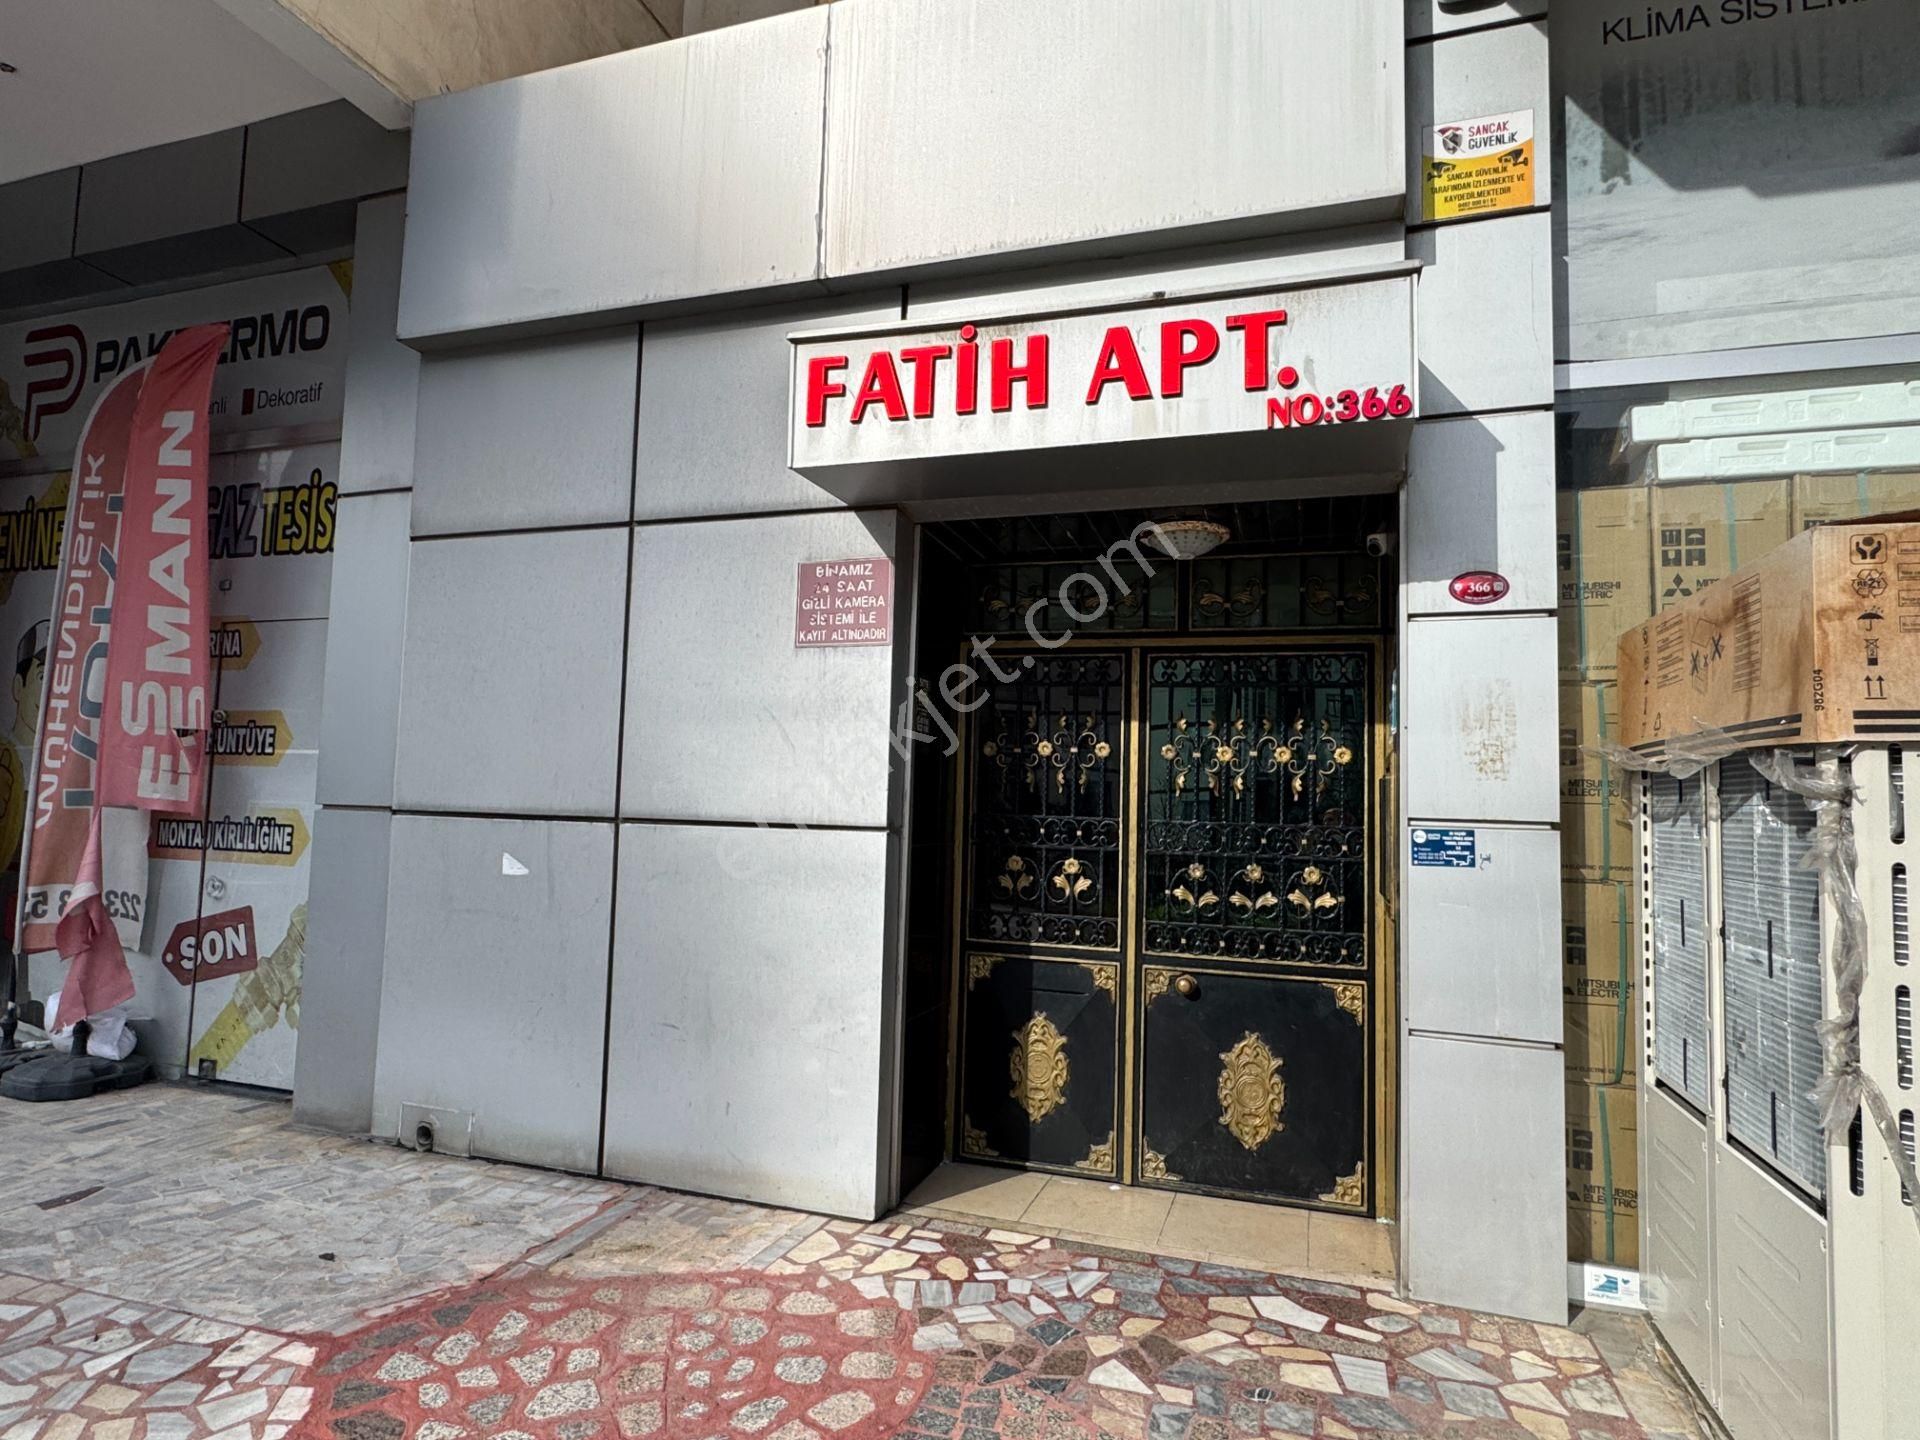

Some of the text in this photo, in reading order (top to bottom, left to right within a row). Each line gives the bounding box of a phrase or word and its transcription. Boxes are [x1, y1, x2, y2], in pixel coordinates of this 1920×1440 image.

[1602, 5, 1710, 45] KLİMA
[1468, 120, 1509, 137] SANCAK
[1468, 131, 1518, 150] GÜVENLİK
[1431, 182, 1471, 194] TARAFINDAN
[1516, 173, 1525, 182] VE
[1446, 165, 1508, 182] SANCAK GÜVENLİK
[93, 304, 330, 383] PAKRMO
[805, 309, 1299, 428] FATİH APT.
[257, 381, 324, 410] Dekoratif
[1266, 384, 1413, 429] NO:366
[261, 468, 338, 556] TESİS
[816, 563, 873, 577] BİNAMIZ
[814, 579, 875, 594] 24 SAAT
[1467, 581, 1491, 593] 366
[802, 594, 885, 610] GİZLİ KAMERA
[809, 609, 877, 625] SİSTEMİ İLE
[799, 627, 886, 642] KAYIT ALTINDADIR
[212, 815, 294, 855] KİRLİLİĞİNE
[180, 923, 248, 971] SON
